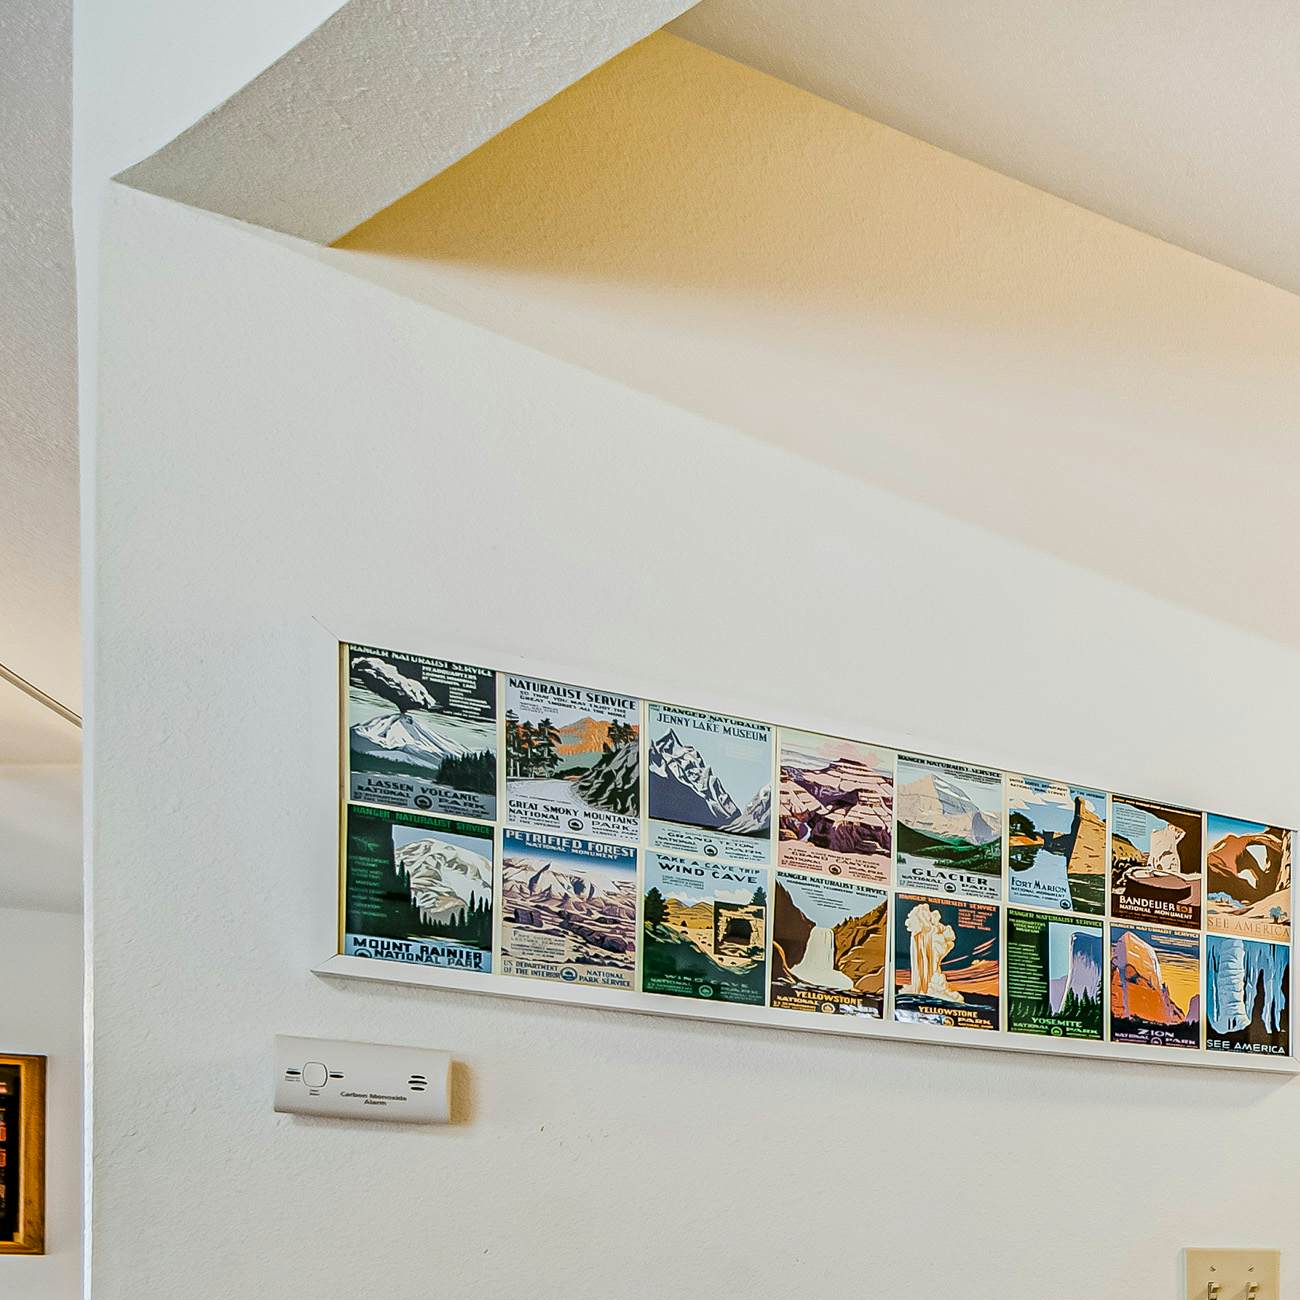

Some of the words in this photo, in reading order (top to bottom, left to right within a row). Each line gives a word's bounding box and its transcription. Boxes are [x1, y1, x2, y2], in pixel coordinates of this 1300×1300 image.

[392, 652, 448, 668] NATURALIST
[452, 663, 492, 677] SERVICE
[509, 677, 582, 700] NATURALIST
[586, 692, 636, 710] SERVICE
[657, 713, 690, 728] JENNY
[693, 720, 720, 733] LAKE
[722, 727, 767, 742] MUSEUM
[709, 714, 771, 732] NATURALIST
[358, 785, 411, 798] NATIONAL
[438, 797, 486, 810] PARK
[368, 779, 414, 792] LASSEN
[420, 787, 479, 802] VOLCANIC
[352, 806, 389, 818] RANGER
[396, 813, 450, 828] NATURALIST
[456, 822, 490, 834] SERVICE
[508, 799, 539, 811] GREAT
[543, 804, 579, 817] SMOKY
[583, 811, 639, 826] MOUNTAINS
[509, 807, 560, 821] NATIONAL
[592, 820, 629, 831] PARK
[506, 829, 583, 849] PETRIFIED
[588, 840, 635, 858] FOREST
[525, 842, 566, 852] NATIONAL
[571, 848, 618, 860] MONUMENT
[656, 854, 686, 864] TAKE
[705, 862, 734, 872] CAVE
[658, 862, 705, 876] WIND
[712, 872, 758, 884] CAVE
[902, 874, 943, 884] NATIONAL
[912, 868, 988, 886] GLACIER
[777, 871, 807, 881] RANGER
[810, 876, 854, 890] NATURALIST
[856, 885, 888, 896] SERVICE
[1012, 877, 1032, 888] FORT
[1033, 880, 1067, 893] MARION
[1119, 895, 1175, 911] BANDELIER
[1119, 904, 1151, 913] NATIONAL
[1154, 909, 1192, 920] MONUMENT
[1009, 909, 1035, 918] RANGER
[1036, 914, 1074, 923] NATURALIST
[1076, 919, 1102, 927] SERVICE
[1208, 916, 1229, 928] SEE
[1235, 921, 1290, 937] AMERICA
[353, 937, 412, 951] MOUNT
[420, 945, 482, 961] RAINIER
[374, 951, 440, 965] NATIONAL
[448, 958, 483, 970] PARK
[516, 961, 558, 971] DEPARTMENT
[579, 975, 600, 984] PARK
[602, 978, 630, 987] SERVICE
[587, 970, 624, 979] NATIONAL
[795, 990, 863, 1005] YELLOWSTONE
[918, 1005, 978, 1018] YELLOWSTONE
[958, 1017, 991, 1025] PARK
[1013, 1022, 1049, 1030] NATIONAL
[1032, 1017, 1082, 1027] YOSEMITE
[1137, 1028, 1175, 1038] ZION
[1207, 1039, 1230, 1049] SEE
[1234, 1042, 1285, 1054] AMERICA
